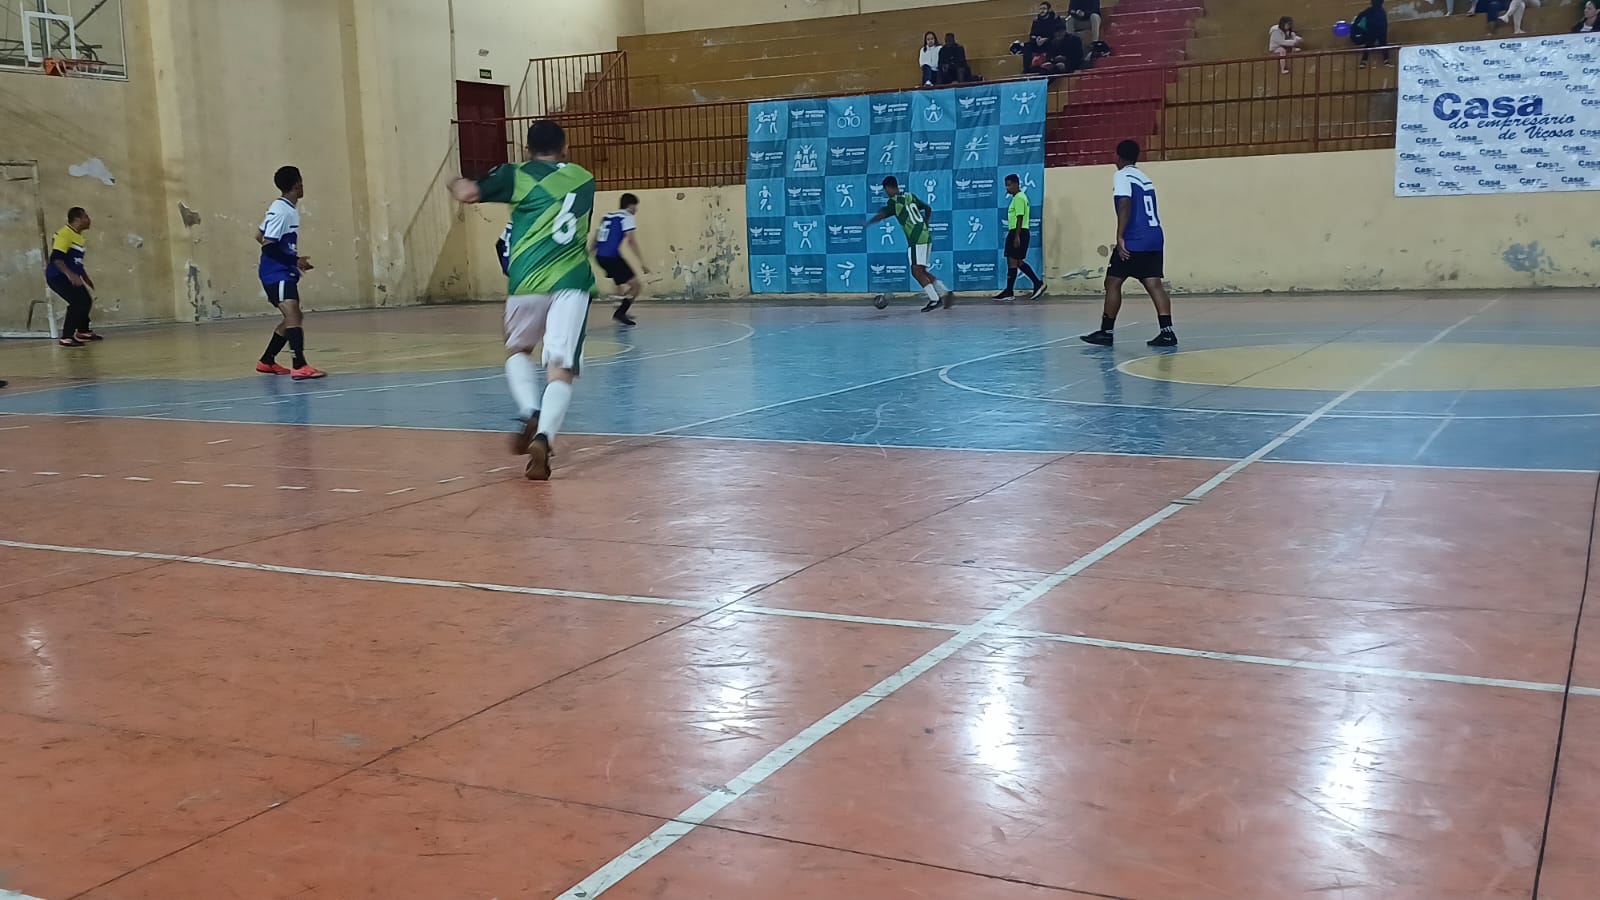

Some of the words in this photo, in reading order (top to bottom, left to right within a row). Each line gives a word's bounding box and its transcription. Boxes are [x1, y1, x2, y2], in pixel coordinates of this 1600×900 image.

[1433, 92, 1543, 121] Casa
[1448, 117, 1469, 129] do
[1477, 113, 1576, 131] empresário
[1498, 129, 1517, 140] de
[1524, 125, 1575, 141] Viçosa
[552, 192, 578, 245] 6
[905, 202, 924, 225] 10
[1143, 195, 1158, 226] 9
